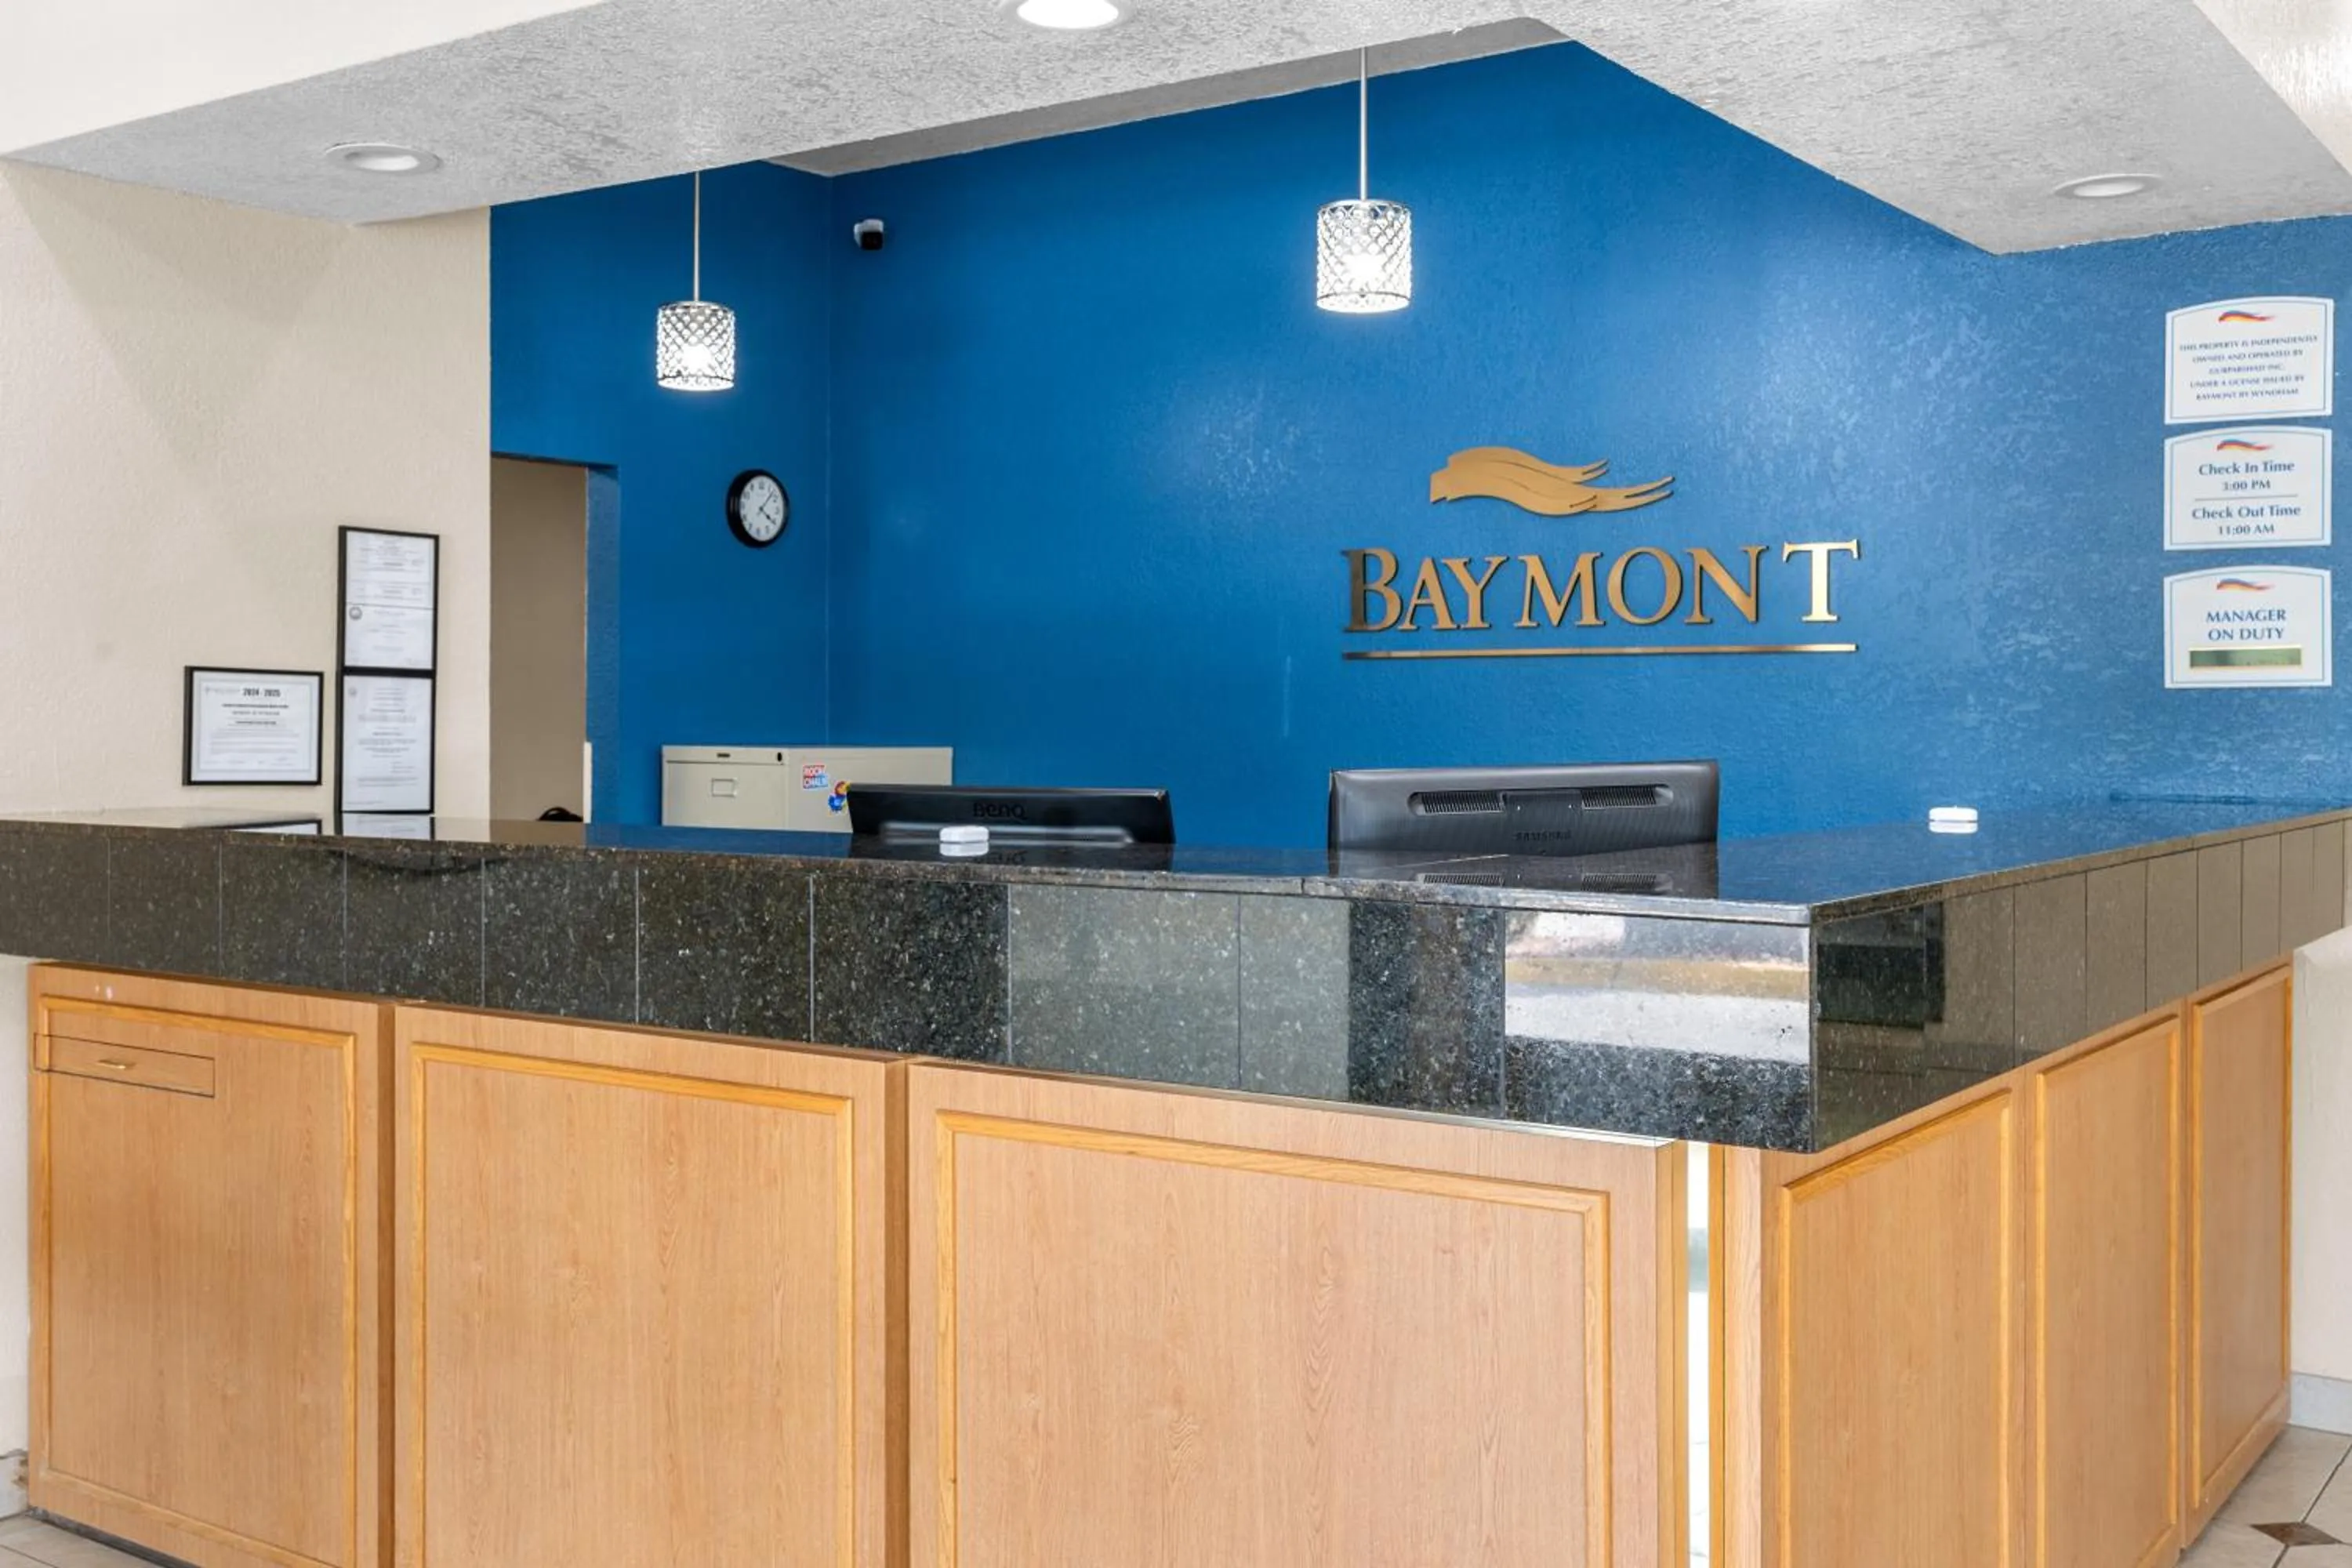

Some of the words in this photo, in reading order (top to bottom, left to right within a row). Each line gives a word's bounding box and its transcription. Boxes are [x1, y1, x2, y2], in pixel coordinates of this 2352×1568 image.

[2198, 340, 2238, 350] PROPERTY
[2251, 334, 2318, 347] INDEPENDENTLY
[2227, 352, 2246, 361] AND
[2248, 350, 2290, 358] OPERATED
[2196, 391, 2237, 401] BAYMONT
[2198, 462, 2241, 476] Check
[2245, 462, 2259, 474] In
[2263, 460, 2295, 473] Time
[2222, 481, 2248, 492] 3:00
[2251, 479, 2271, 490] PM
[2191, 506, 2233, 520] Check
[2238, 506, 2264, 517] Out
[2268, 505, 2301, 517] Time
[2218, 524, 2251, 536] 11:00
[2253, 524, 2274, 535] AM
[1341, 539, 1859, 633] BAYMONT
[2205, 608, 2286, 622] MANAGER
[2208, 628, 2233, 641] ON
[2239, 627, 2284, 640] DUTY
[973, 801, 1029, 821] BenQ
